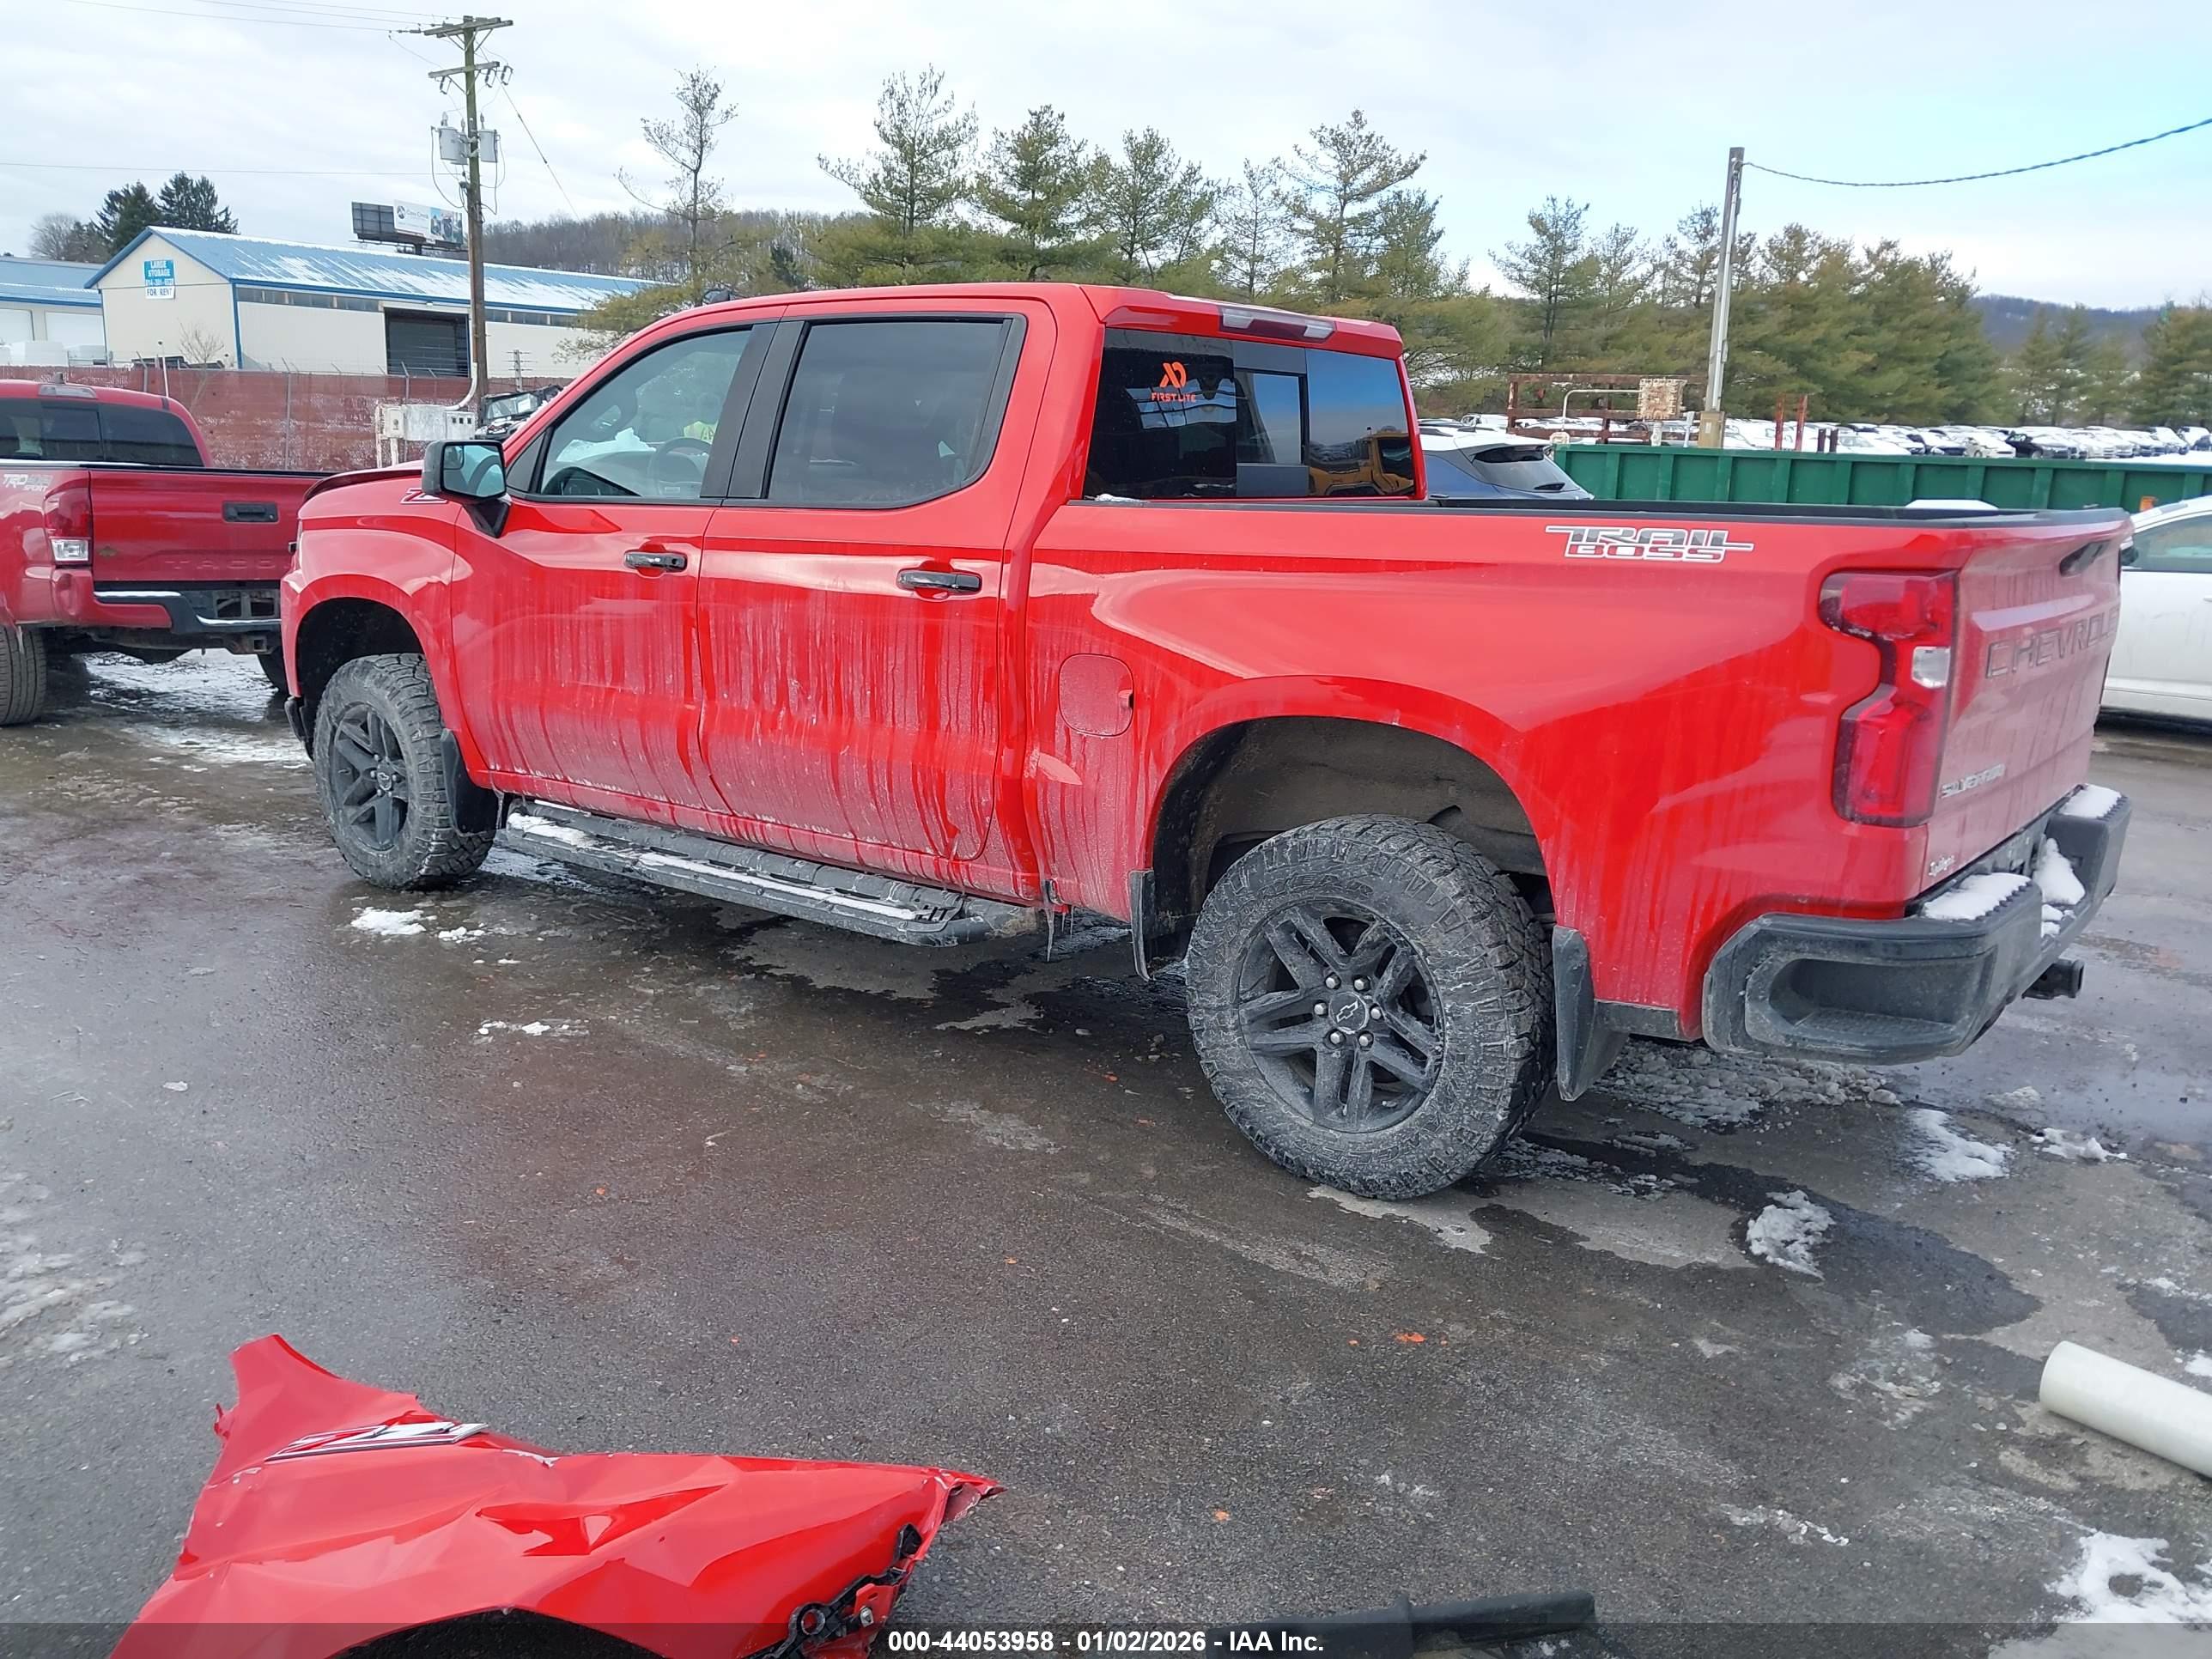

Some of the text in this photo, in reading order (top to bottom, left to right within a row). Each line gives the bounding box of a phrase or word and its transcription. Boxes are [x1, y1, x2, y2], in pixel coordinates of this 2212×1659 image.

[148, 268, 170, 277] STORAGE
[1152, 392, 1177, 403] FIRST
[3, 473, 28, 489] TRD
[1546, 526, 1754, 551] TRAIL
[1565, 542, 1726, 563] BOSS
[164, 559, 290, 571] TACO
[1985, 606, 2121, 679] CHEVROLE
